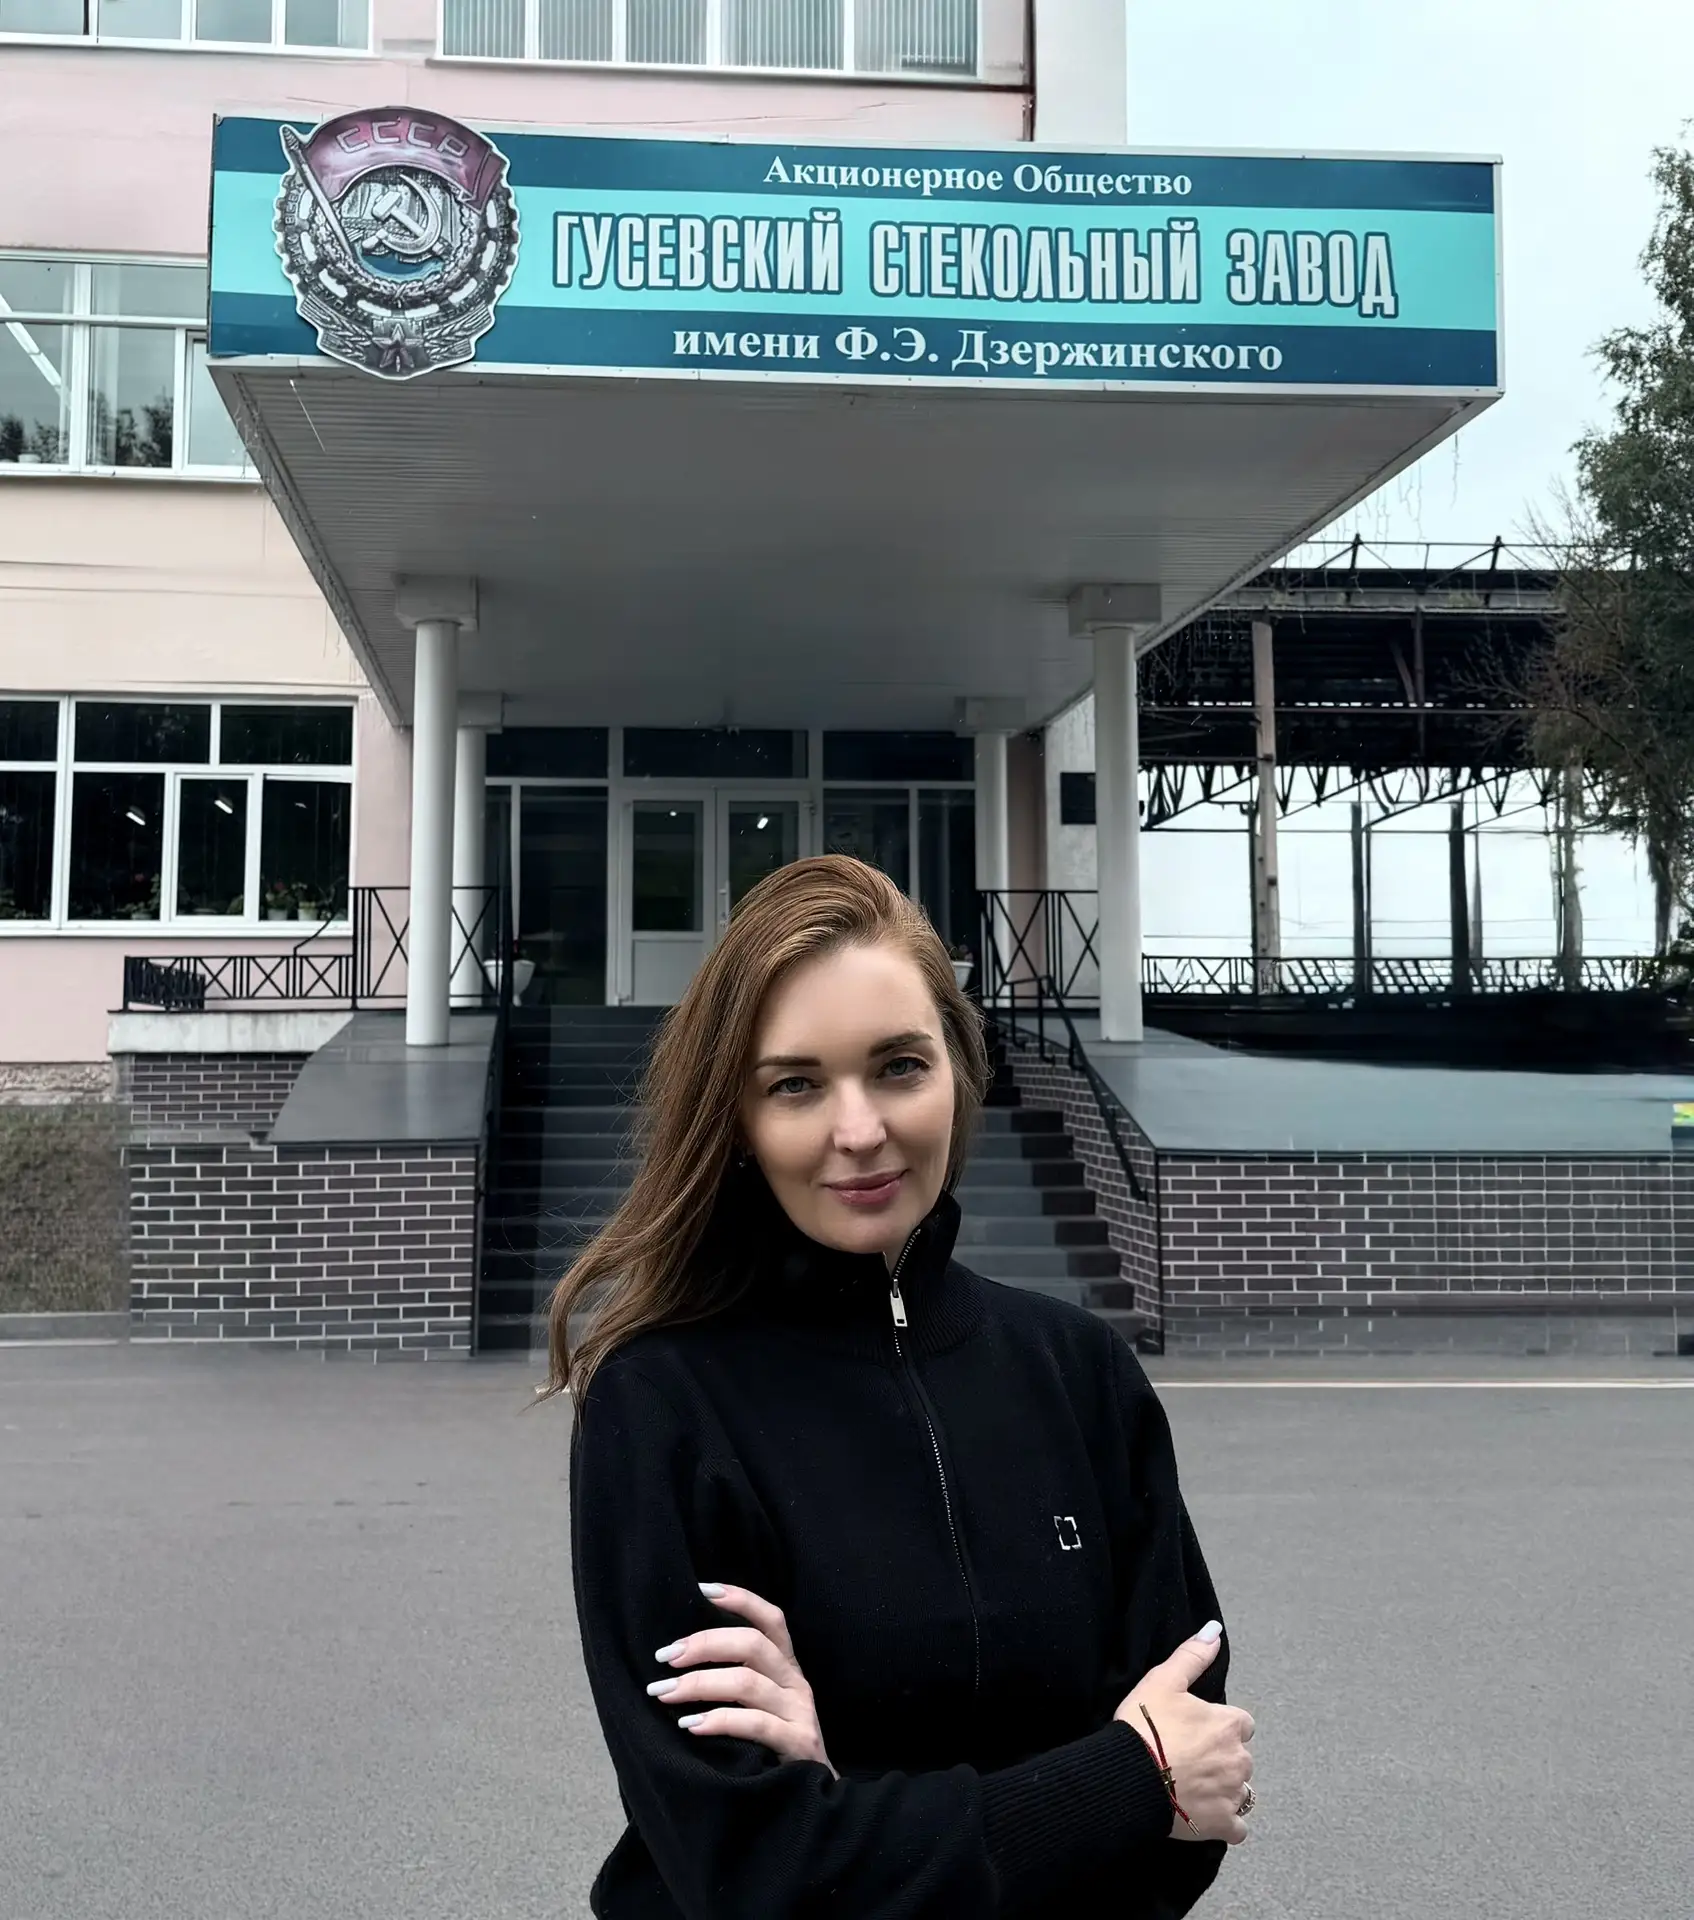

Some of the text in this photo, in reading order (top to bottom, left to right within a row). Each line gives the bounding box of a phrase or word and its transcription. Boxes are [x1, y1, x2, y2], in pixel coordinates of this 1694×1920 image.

[336, 121, 469, 158] СССР
[763, 155, 1192, 198] Акционерное Общество
[555, 209, 841, 293] ГУСЕВСКИЙ
[871, 219, 1199, 302] СТЕКОЛЬНЫЙ
[1228, 230, 1397, 317] ЗАВОД
[673, 326, 1282, 375] имени Ф.Э. Дзержинского
